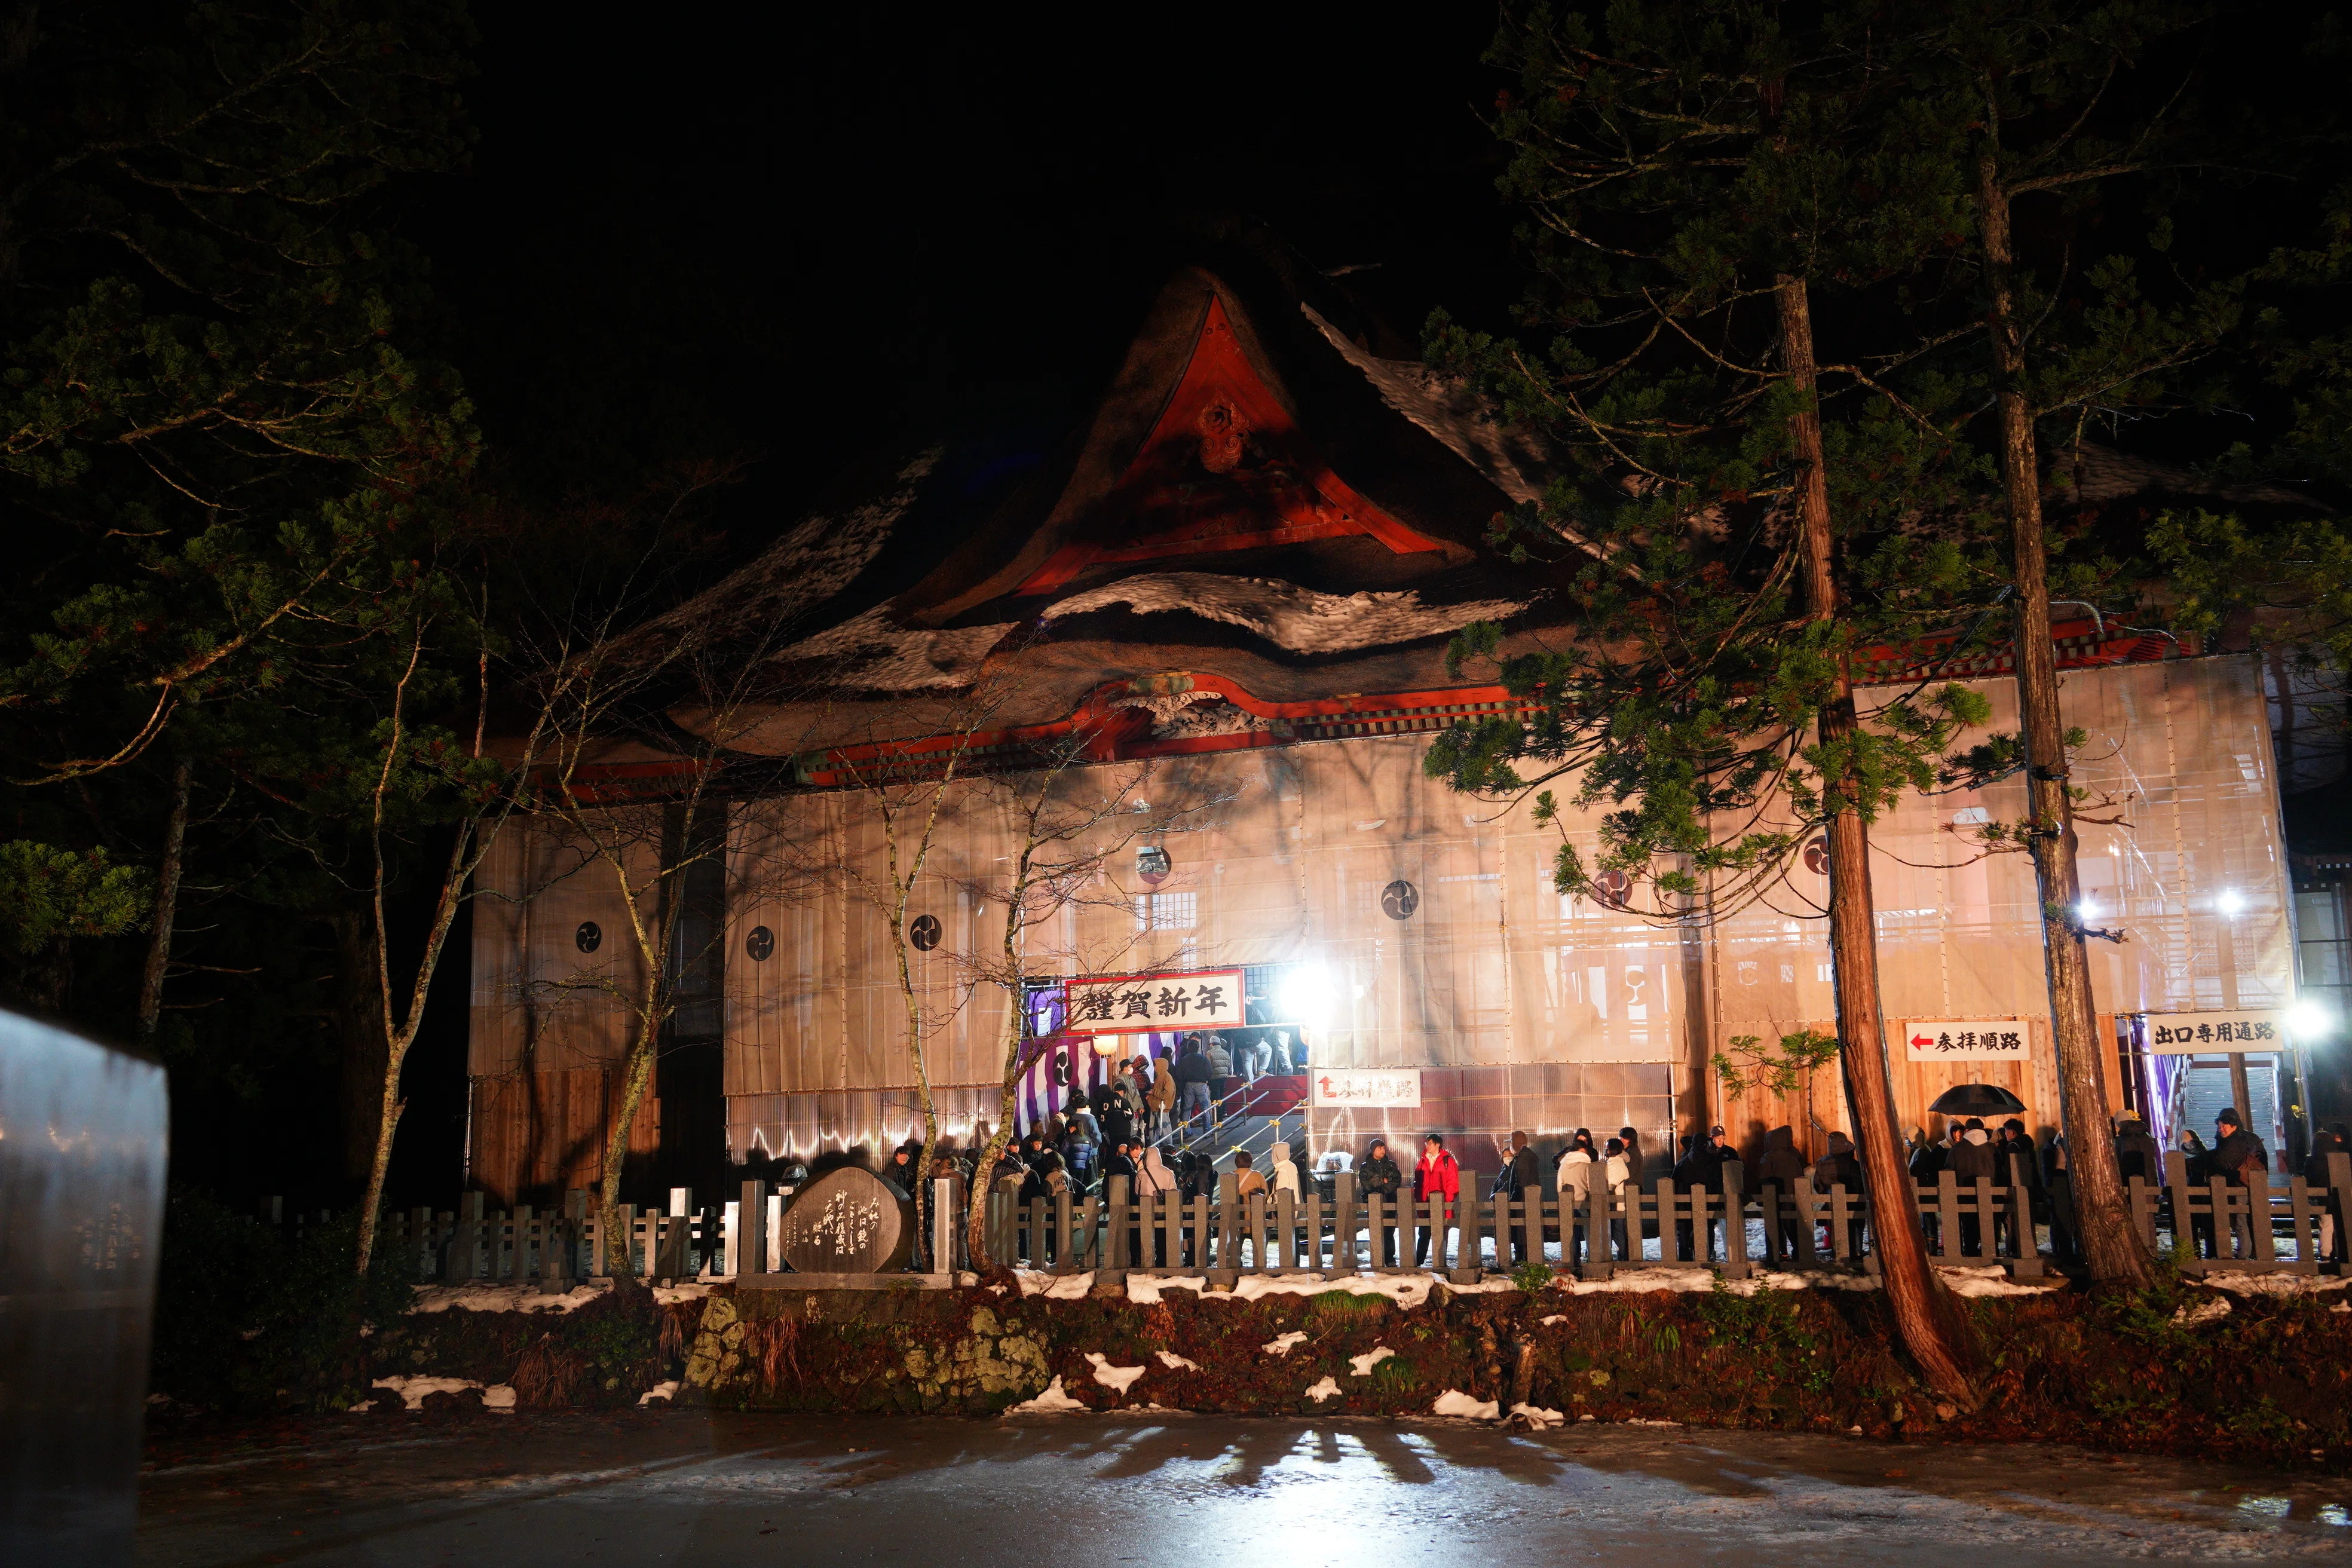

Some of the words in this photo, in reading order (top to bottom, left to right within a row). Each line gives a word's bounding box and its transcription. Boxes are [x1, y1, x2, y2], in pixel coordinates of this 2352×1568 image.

[1082, 984, 1227, 1021] 謹賀新年
[1934, 1031, 2022, 1052] 参拝順路
[2155, 1021, 2276, 1045] 出口専用通路
